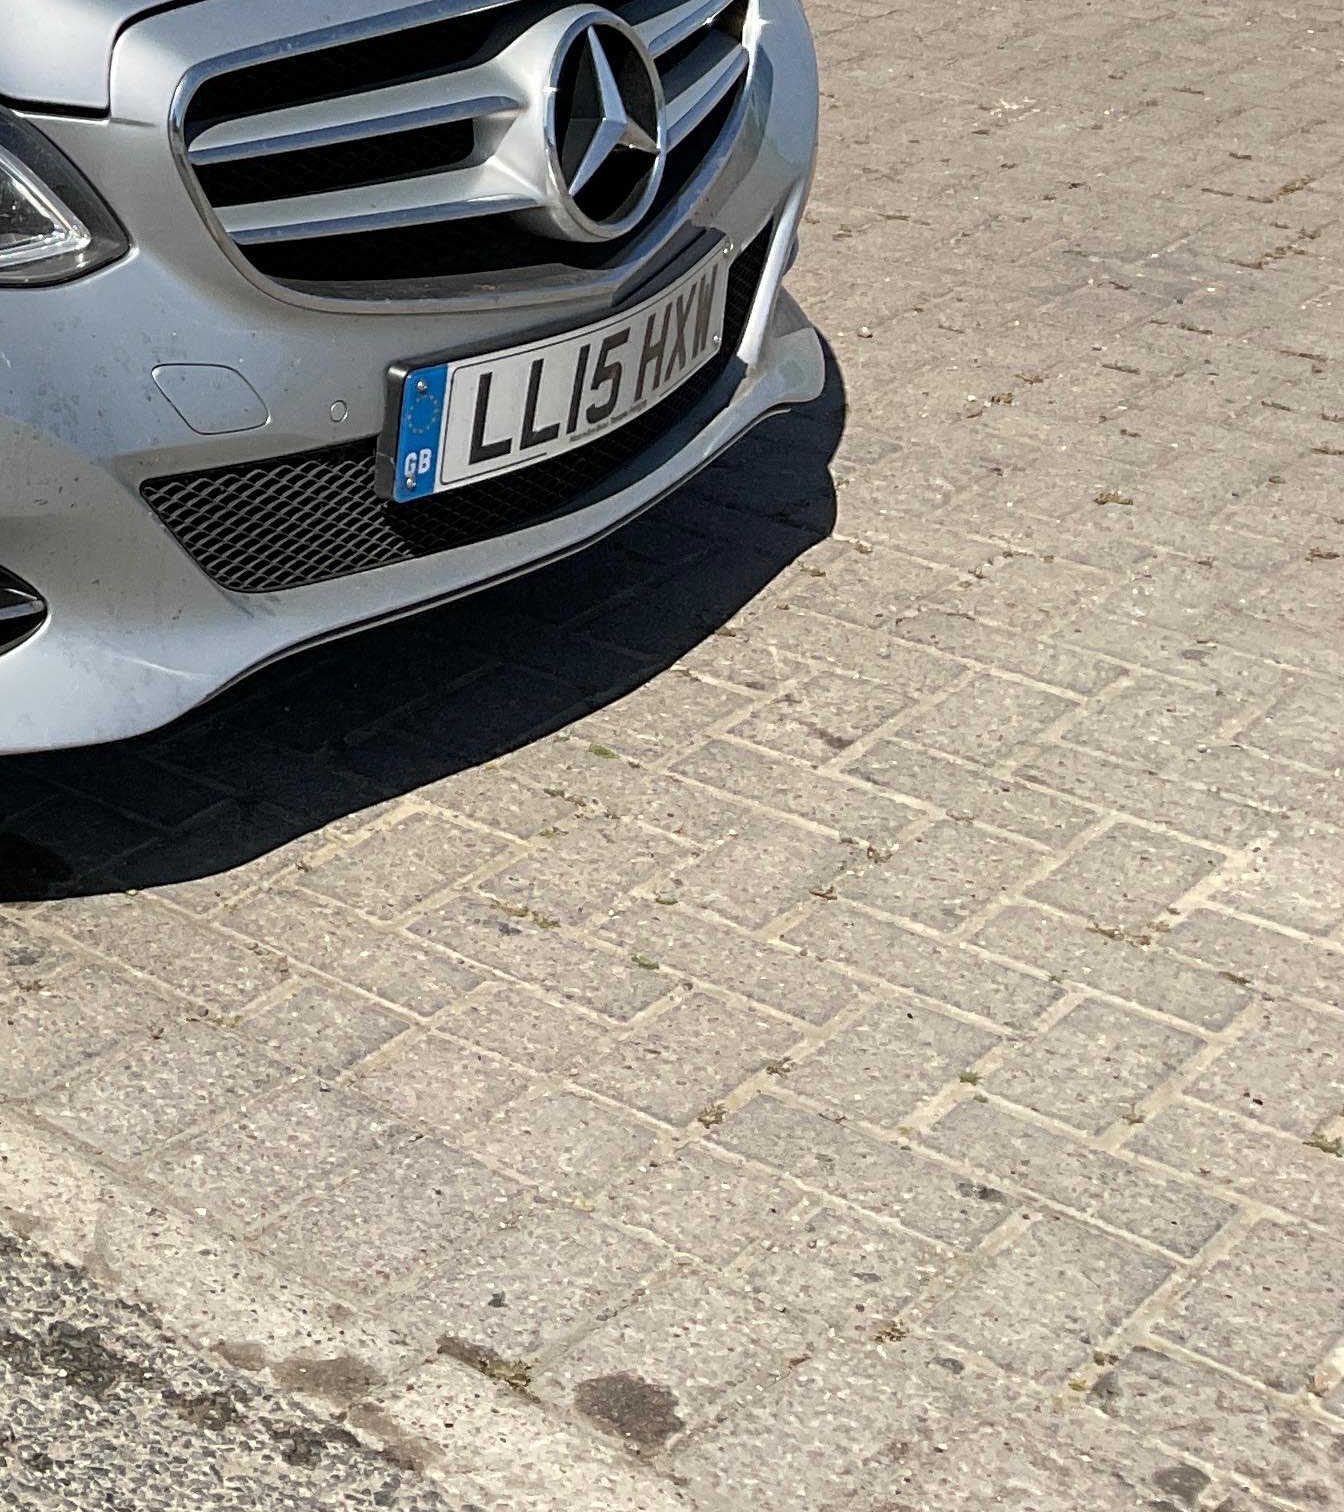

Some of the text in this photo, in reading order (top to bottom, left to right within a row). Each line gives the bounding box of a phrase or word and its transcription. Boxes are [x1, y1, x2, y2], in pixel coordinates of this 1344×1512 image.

[468, 263, 719, 466] LL15 HXW
[404, 448, 432, 477] GB
